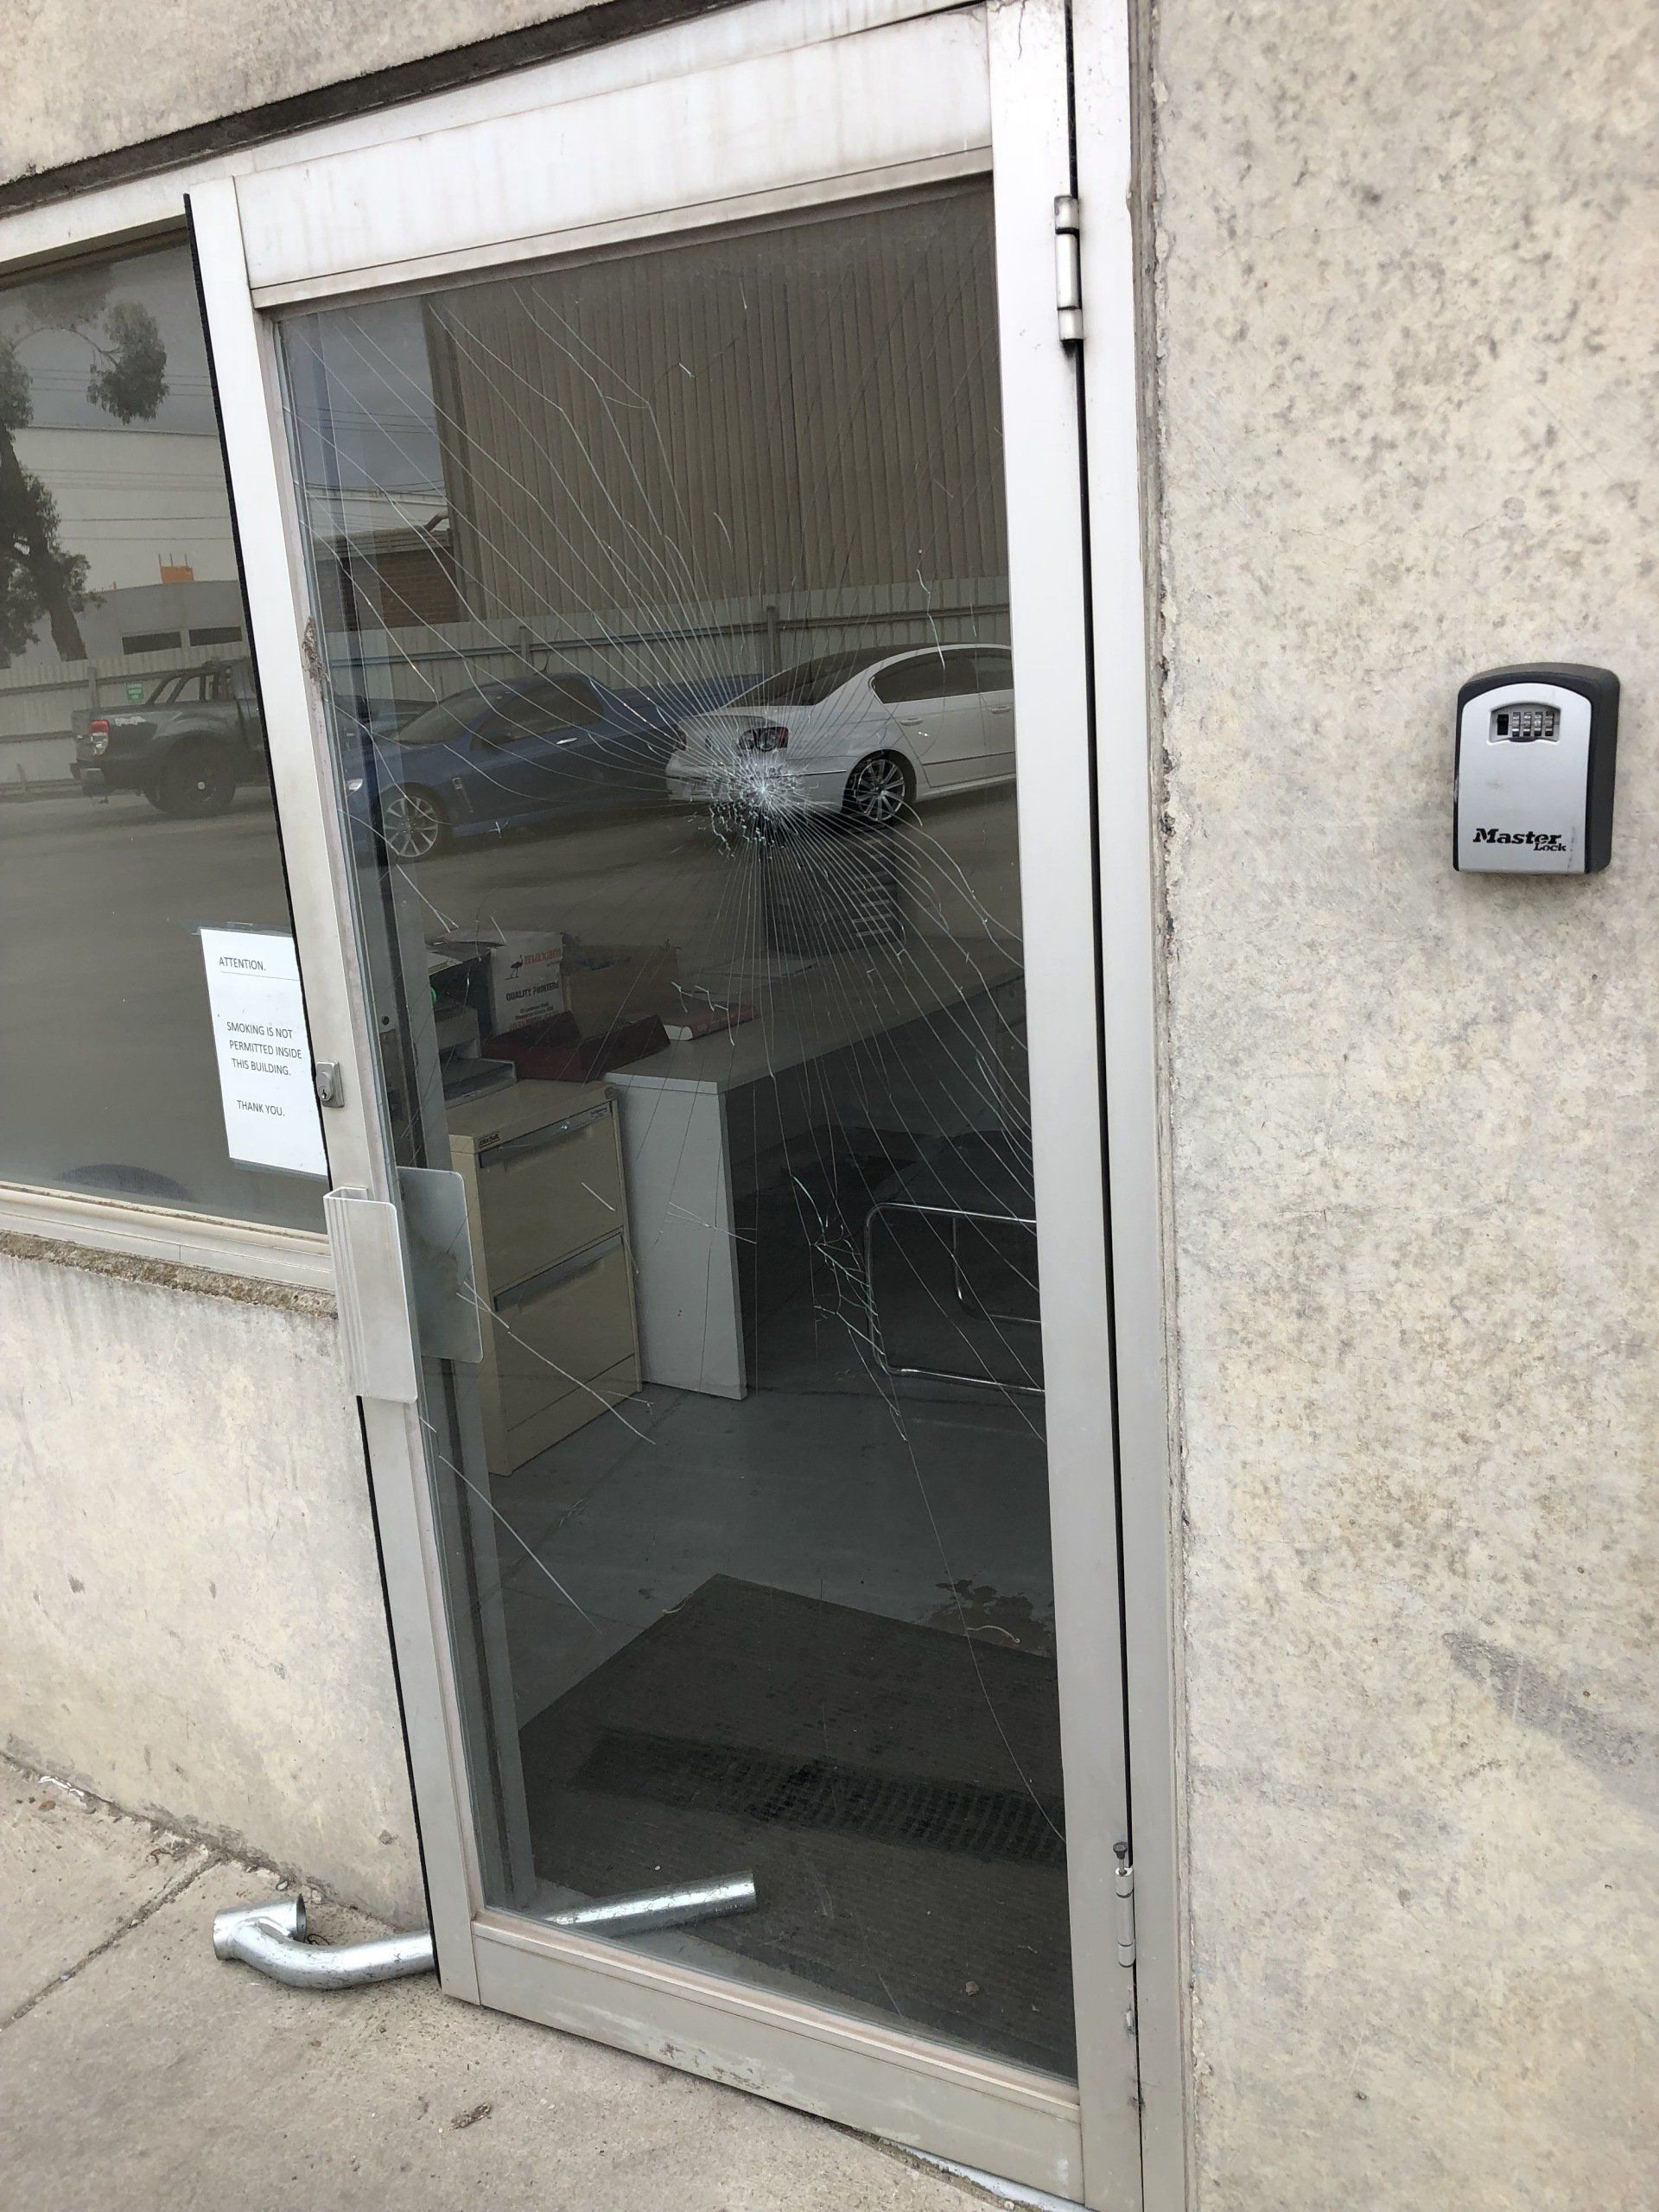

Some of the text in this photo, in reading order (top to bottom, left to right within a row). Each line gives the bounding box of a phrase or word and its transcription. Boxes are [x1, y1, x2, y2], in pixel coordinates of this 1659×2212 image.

[1472, 828, 1562, 845] Master
[1533, 842, 1567, 852] Lock
[219, 957, 266, 971] ATTENTION.
[505, 988, 531, 1001] QUALITY
[226, 1021, 293, 1039] SMOKING IS NOT
[229, 1039, 302, 1059] PERMITTED INSIDE
[231, 1058, 291, 1077] THIS BUILDING.
[236, 1099, 286, 1116] THANK YOU.
